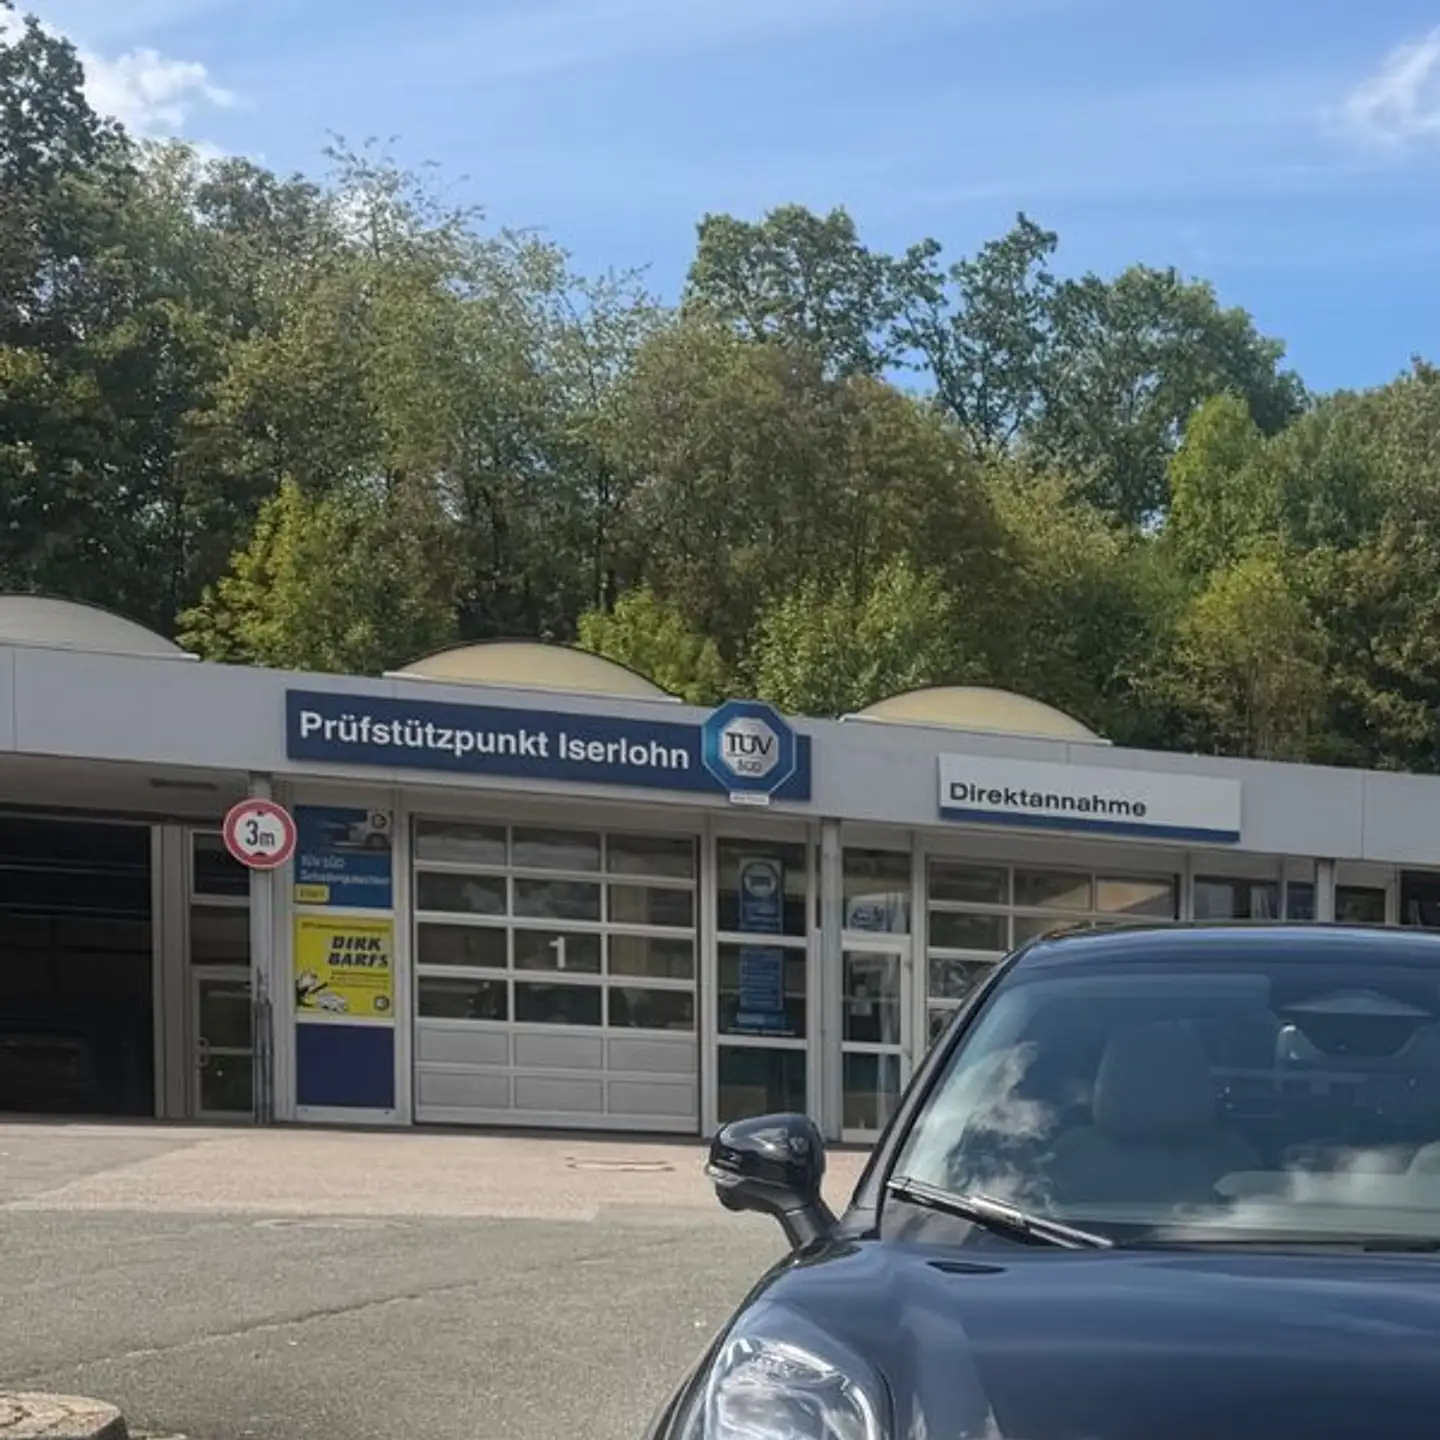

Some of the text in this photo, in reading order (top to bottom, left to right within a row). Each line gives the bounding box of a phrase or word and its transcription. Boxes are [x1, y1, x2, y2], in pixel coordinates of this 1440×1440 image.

[299, 709, 690, 770] Prüfstützpunkt Iserlohn
[949, 782, 1146, 817] Direktannahme
[332, 935, 382, 951] DIRK
[549, 936, 566, 968] 1
